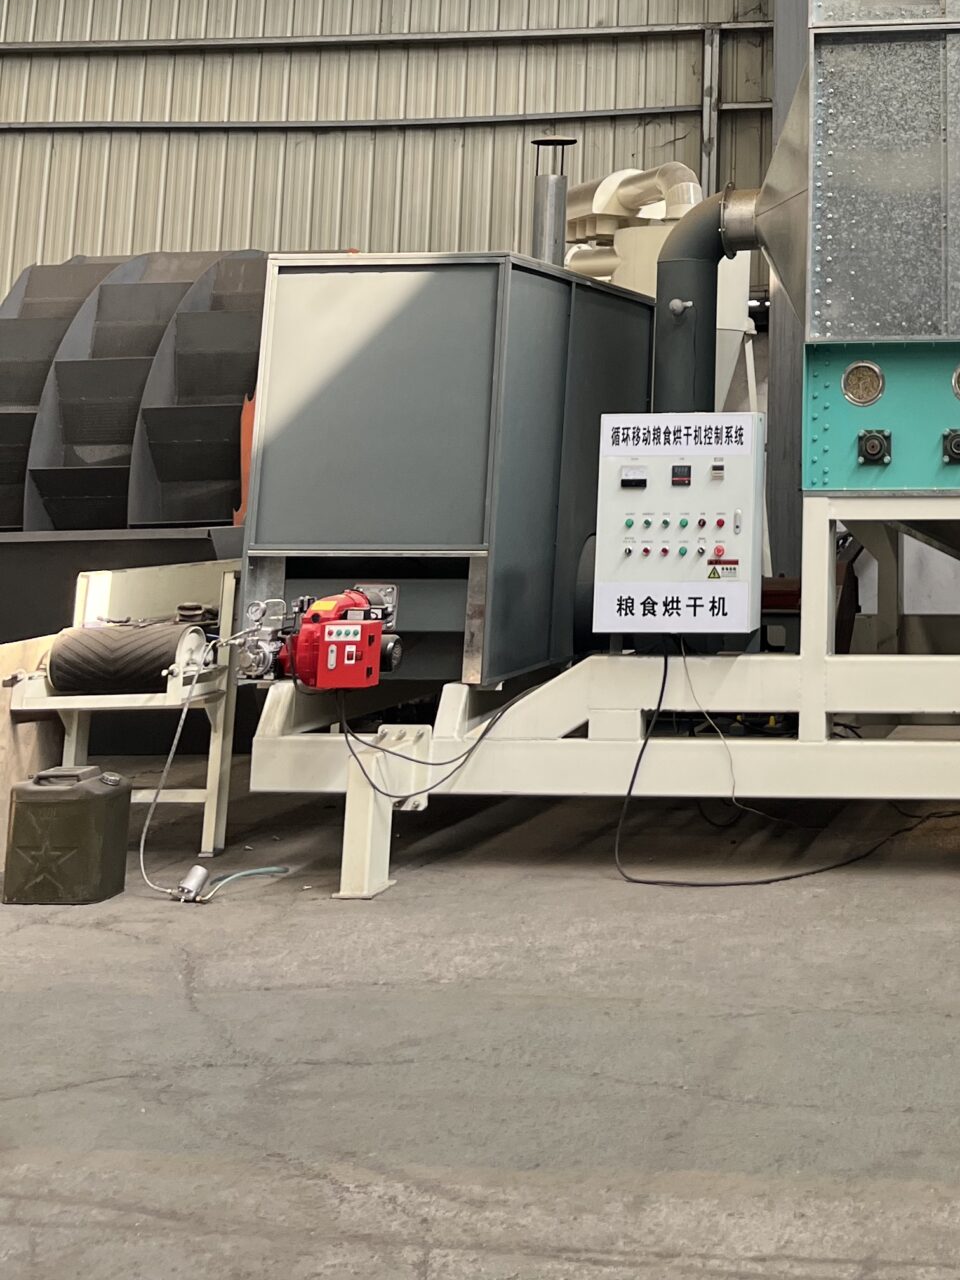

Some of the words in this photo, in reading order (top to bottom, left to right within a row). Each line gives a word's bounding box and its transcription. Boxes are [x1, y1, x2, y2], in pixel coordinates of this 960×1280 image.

[611, 425, 744, 447] 循环移动粮食烘干机控制系统
[616, 595, 728, 617] 粮食烘干机
